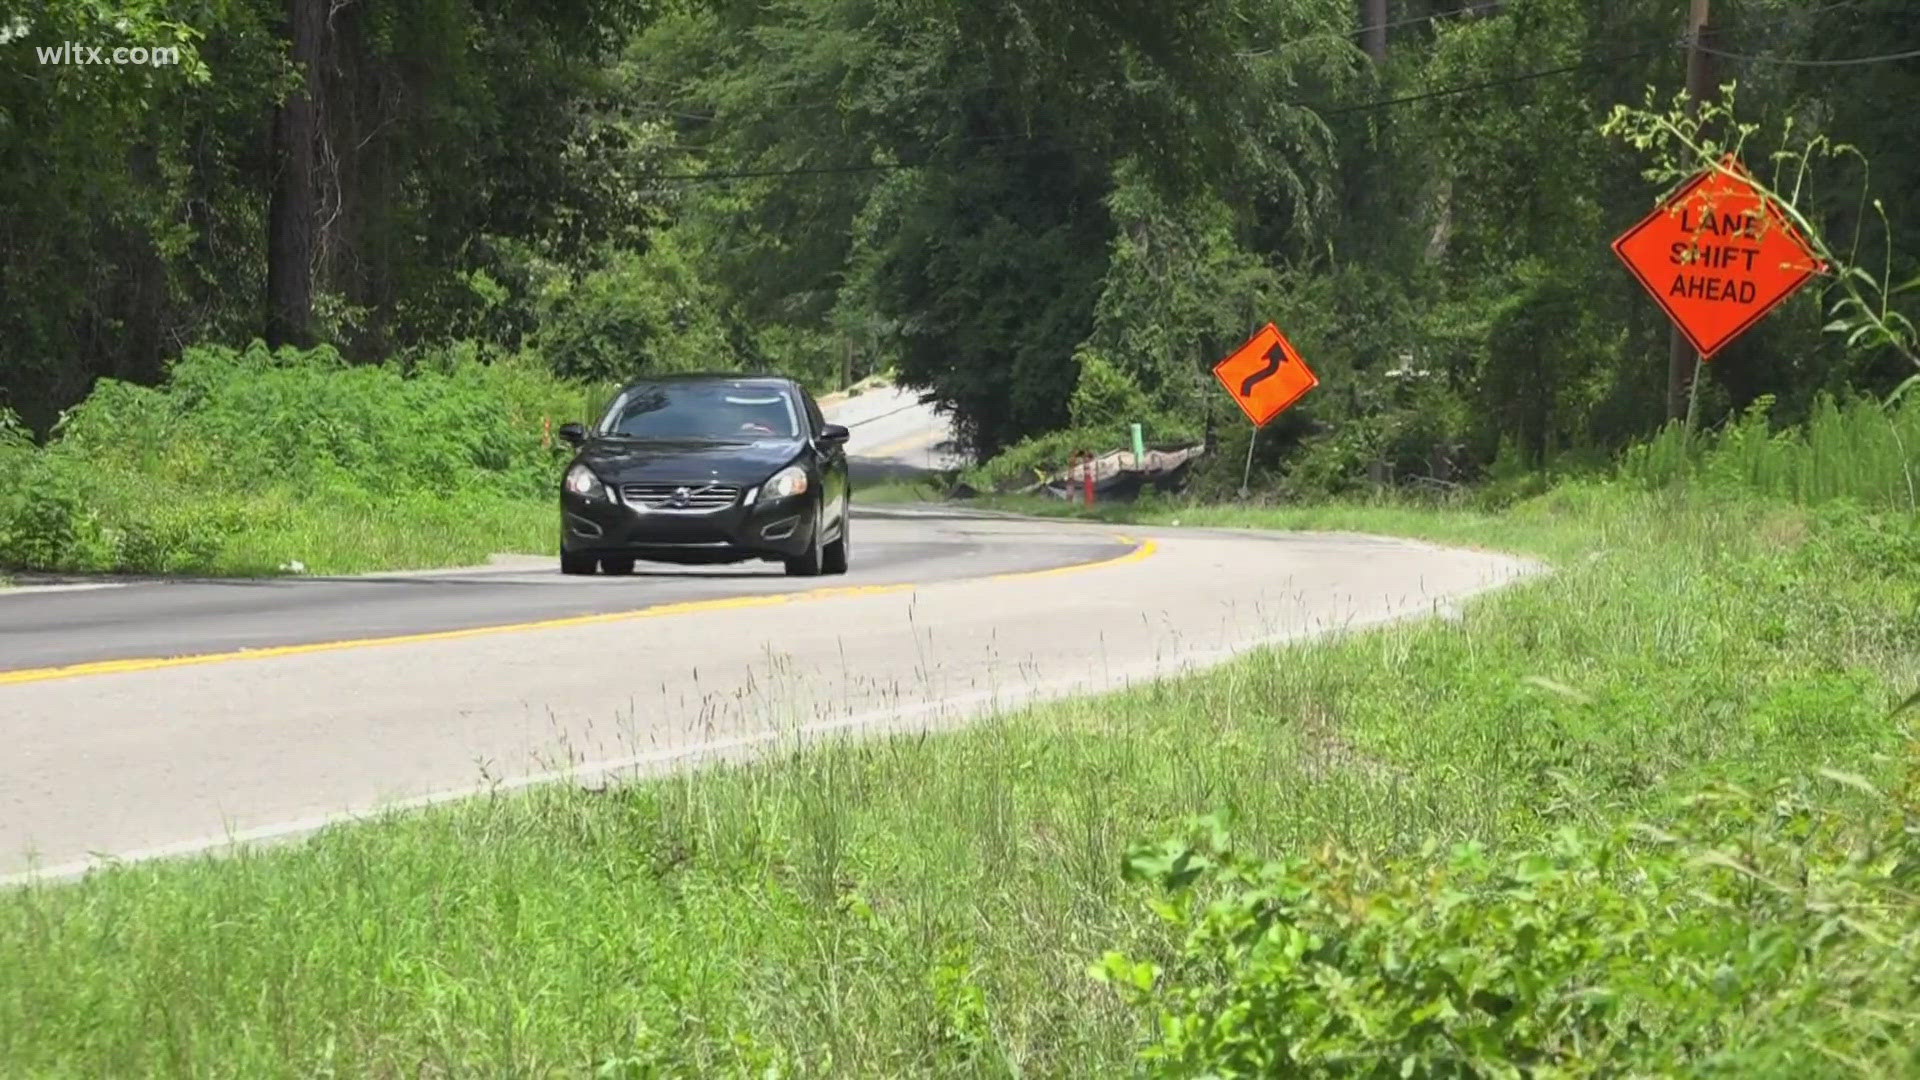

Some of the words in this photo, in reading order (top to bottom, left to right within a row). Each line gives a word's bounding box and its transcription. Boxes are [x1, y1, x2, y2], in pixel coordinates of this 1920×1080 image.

[1681, 209, 1761, 239] LANE
[1669, 241, 1761, 272] SHIFT
[1669, 273, 1757, 304] AHEAD
